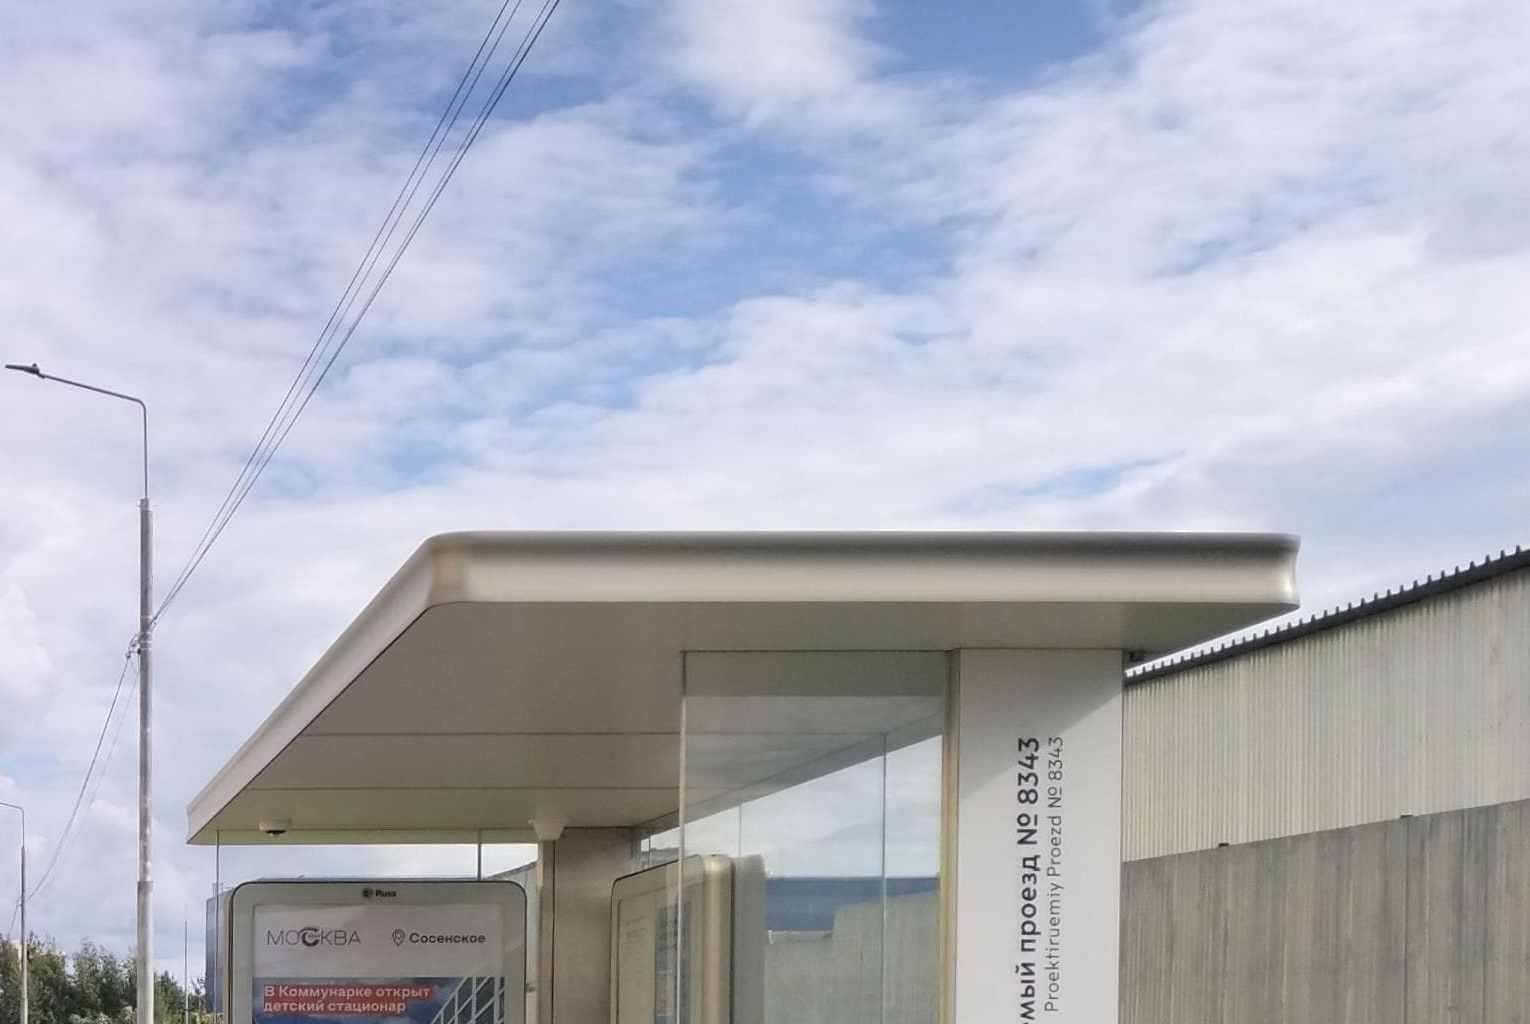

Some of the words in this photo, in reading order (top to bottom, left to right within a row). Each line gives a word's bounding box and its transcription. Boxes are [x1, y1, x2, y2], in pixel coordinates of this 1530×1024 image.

[1017, 737, 1040, 805] 8343
[1047, 736, 1064, 781] 8343
[1047, 786, 1063, 808] №
[1016, 812, 1038, 845] №
[1046, 815, 1062, 877] Proezd
[1020, 854, 1041, 953] проезд
[267, 926, 362, 947] МОСКВА
[409, 932, 486, 944] Сосенское
[1044, 882, 1065, 1012] Proektiruemiy
[263, 1000, 327, 1013] детский
[327, 1001, 407, 1015] стационар
[264, 985, 275, 997] В
[278, 985, 372, 1000] Коммунарке
[375, 987, 431, 1001] открыт
